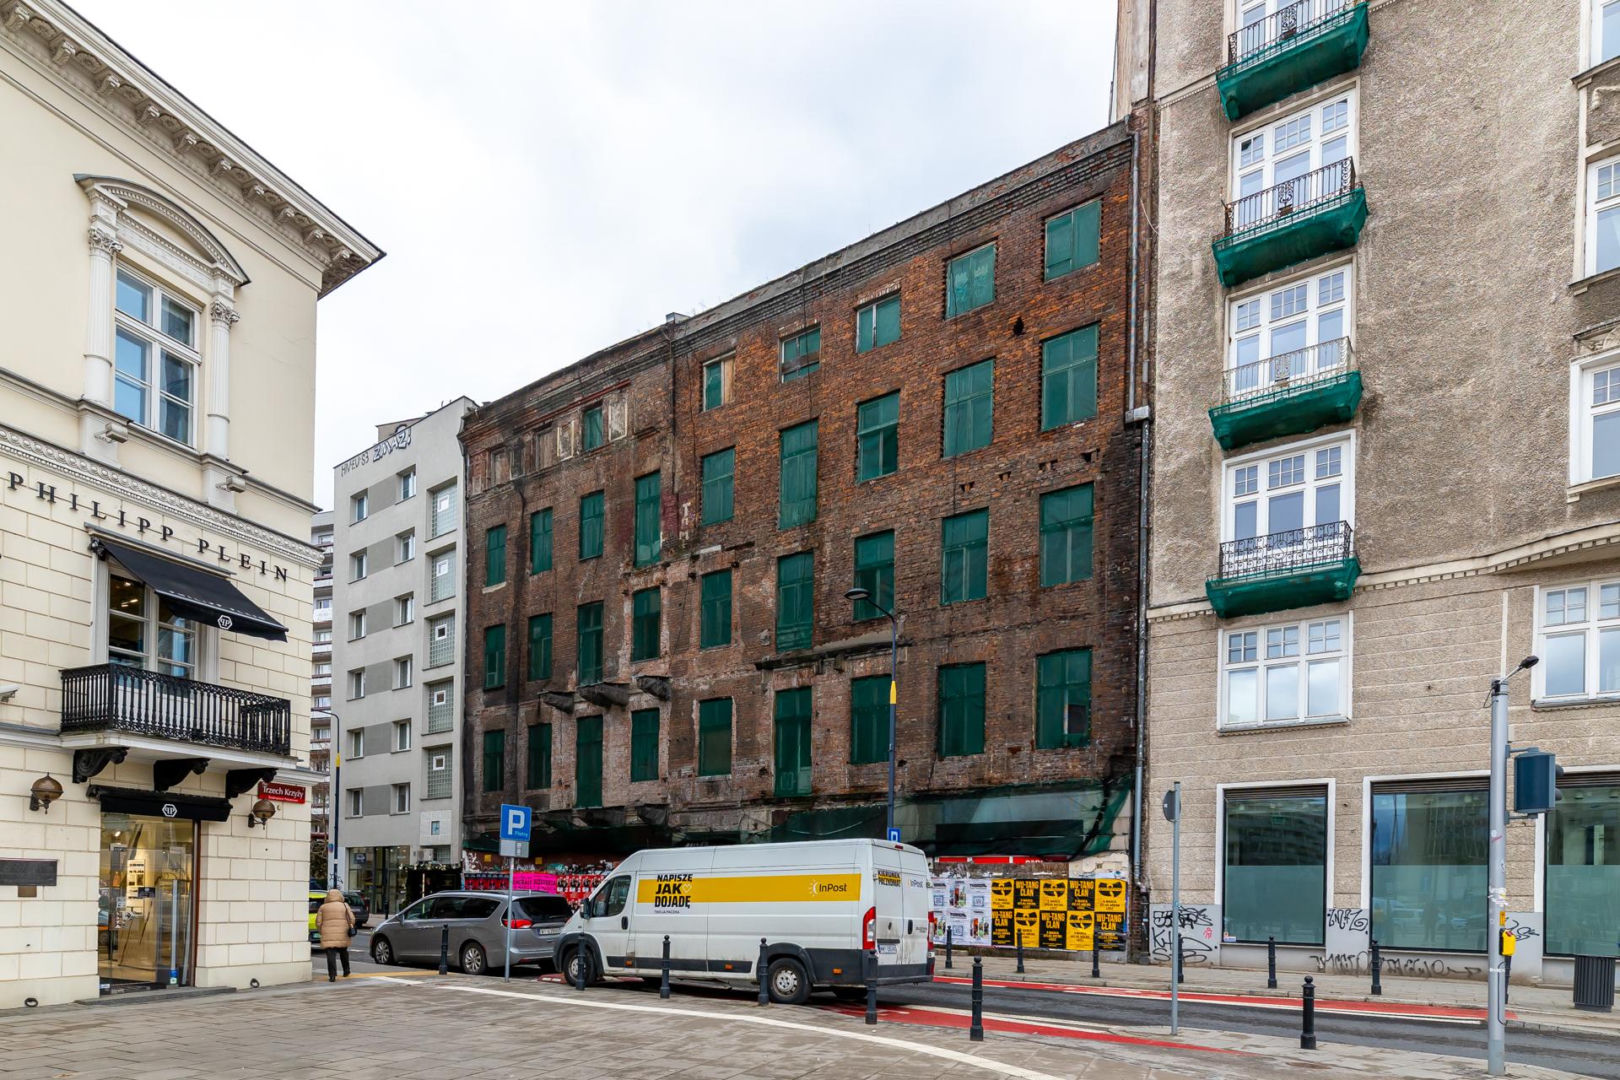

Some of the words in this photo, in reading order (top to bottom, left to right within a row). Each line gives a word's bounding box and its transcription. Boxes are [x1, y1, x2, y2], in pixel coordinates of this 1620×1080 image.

[8, 471, 174, 542] PHILIPP
[197, 538, 287, 582] PLEIN
[263, 786, 284, 796] Trzech
[508, 809, 525, 835] P
[656, 883, 682, 894] JAK
[819, 883, 847, 892] InPost
[1016, 881, 1039, 889] WU-TANG
[1070, 881, 1094, 890] WU-TANG
[1020, 888, 1034, 897] CLAN
[1075, 889, 1089, 897] CLAN
[654, 895, 691, 909] DOJADĘ
[1042, 912, 1065, 921] WU-TANG
[1096, 914, 1121, 922] WU-TANG
[995, 918, 1008, 926] CLAN
[1046, 920, 1060, 929] CLAN
[1101, 921, 1116, 930] CLAN
